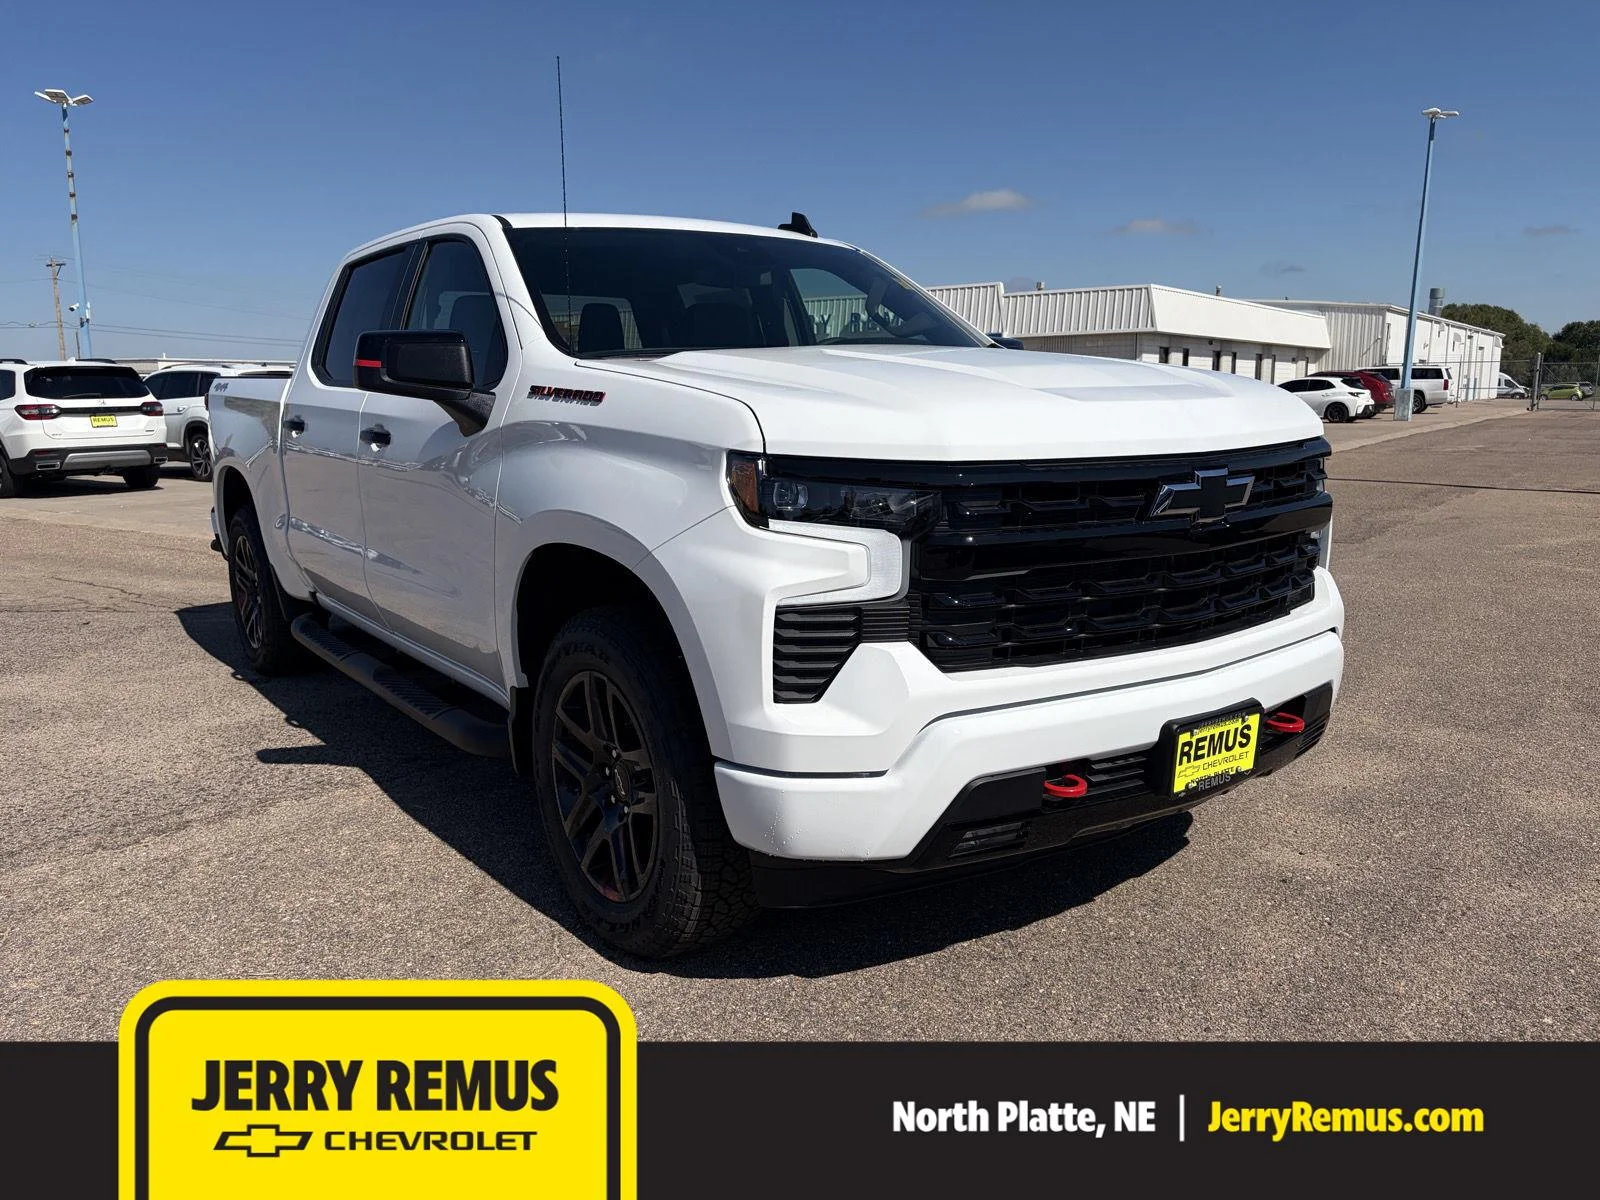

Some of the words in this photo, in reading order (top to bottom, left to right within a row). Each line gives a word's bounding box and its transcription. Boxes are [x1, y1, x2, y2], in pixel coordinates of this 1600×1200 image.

[528, 385, 606, 404] SILVERADO
[1178, 723, 1252, 767] REMUS
[1202, 750, 1250, 770] CHEVROLET
[1198, 773, 1232, 792] REMUS
